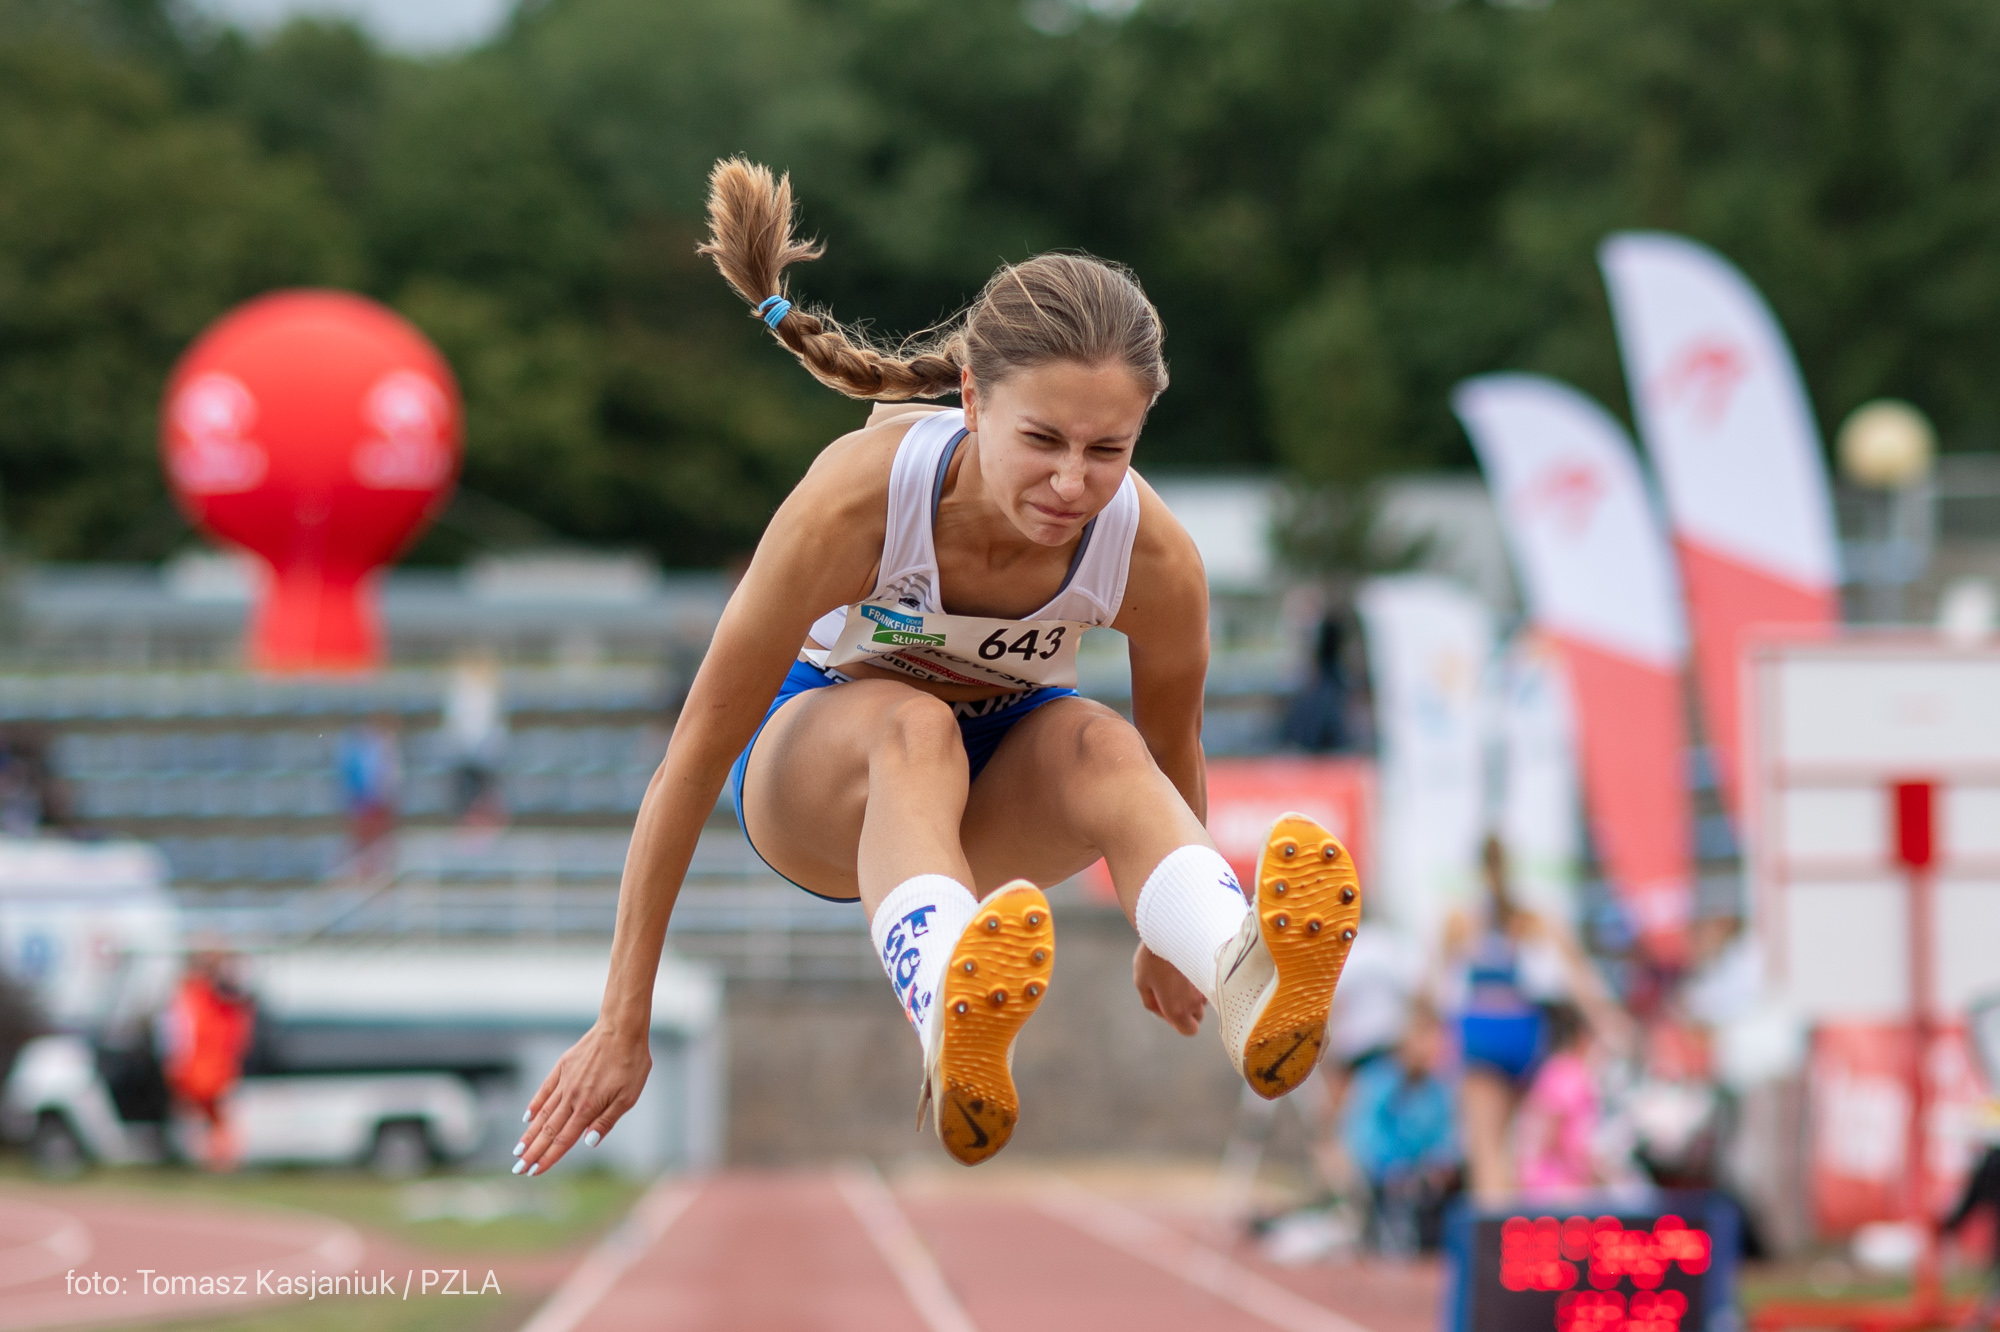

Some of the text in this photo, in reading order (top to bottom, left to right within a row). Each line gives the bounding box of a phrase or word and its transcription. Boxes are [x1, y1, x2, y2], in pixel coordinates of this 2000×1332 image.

[868, 608, 924, 634] FRANKFURT
[856, 643, 870, 654] Ohne
[978, 626, 1066, 661] 643
